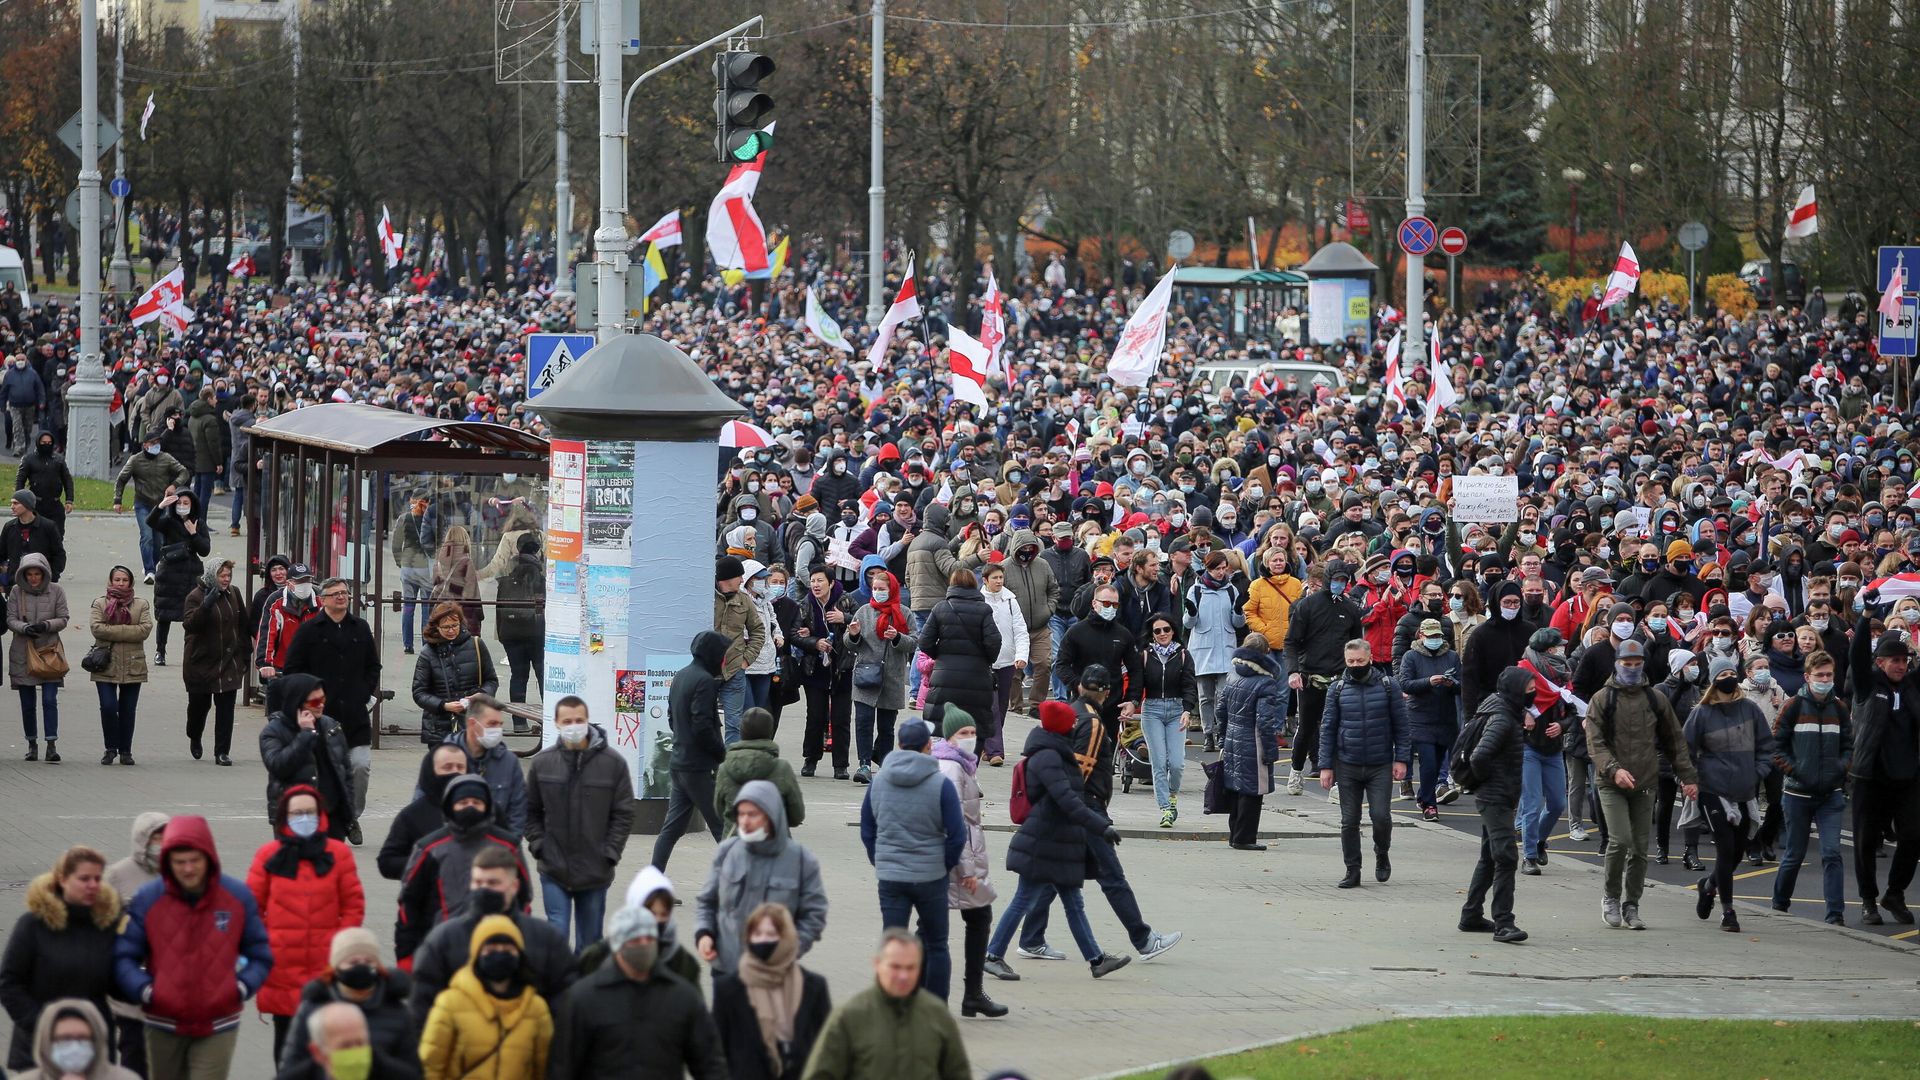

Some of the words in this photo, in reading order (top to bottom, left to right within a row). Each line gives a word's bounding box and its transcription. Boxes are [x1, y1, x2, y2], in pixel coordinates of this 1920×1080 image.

[587, 478, 605, 487] WORLD
[606, 478, 633, 487] LEGENDS
[595, 487, 632, 506] ROCK
[647, 669, 677, 677] Позаботьс
[651, 681, 664, 689] уже
